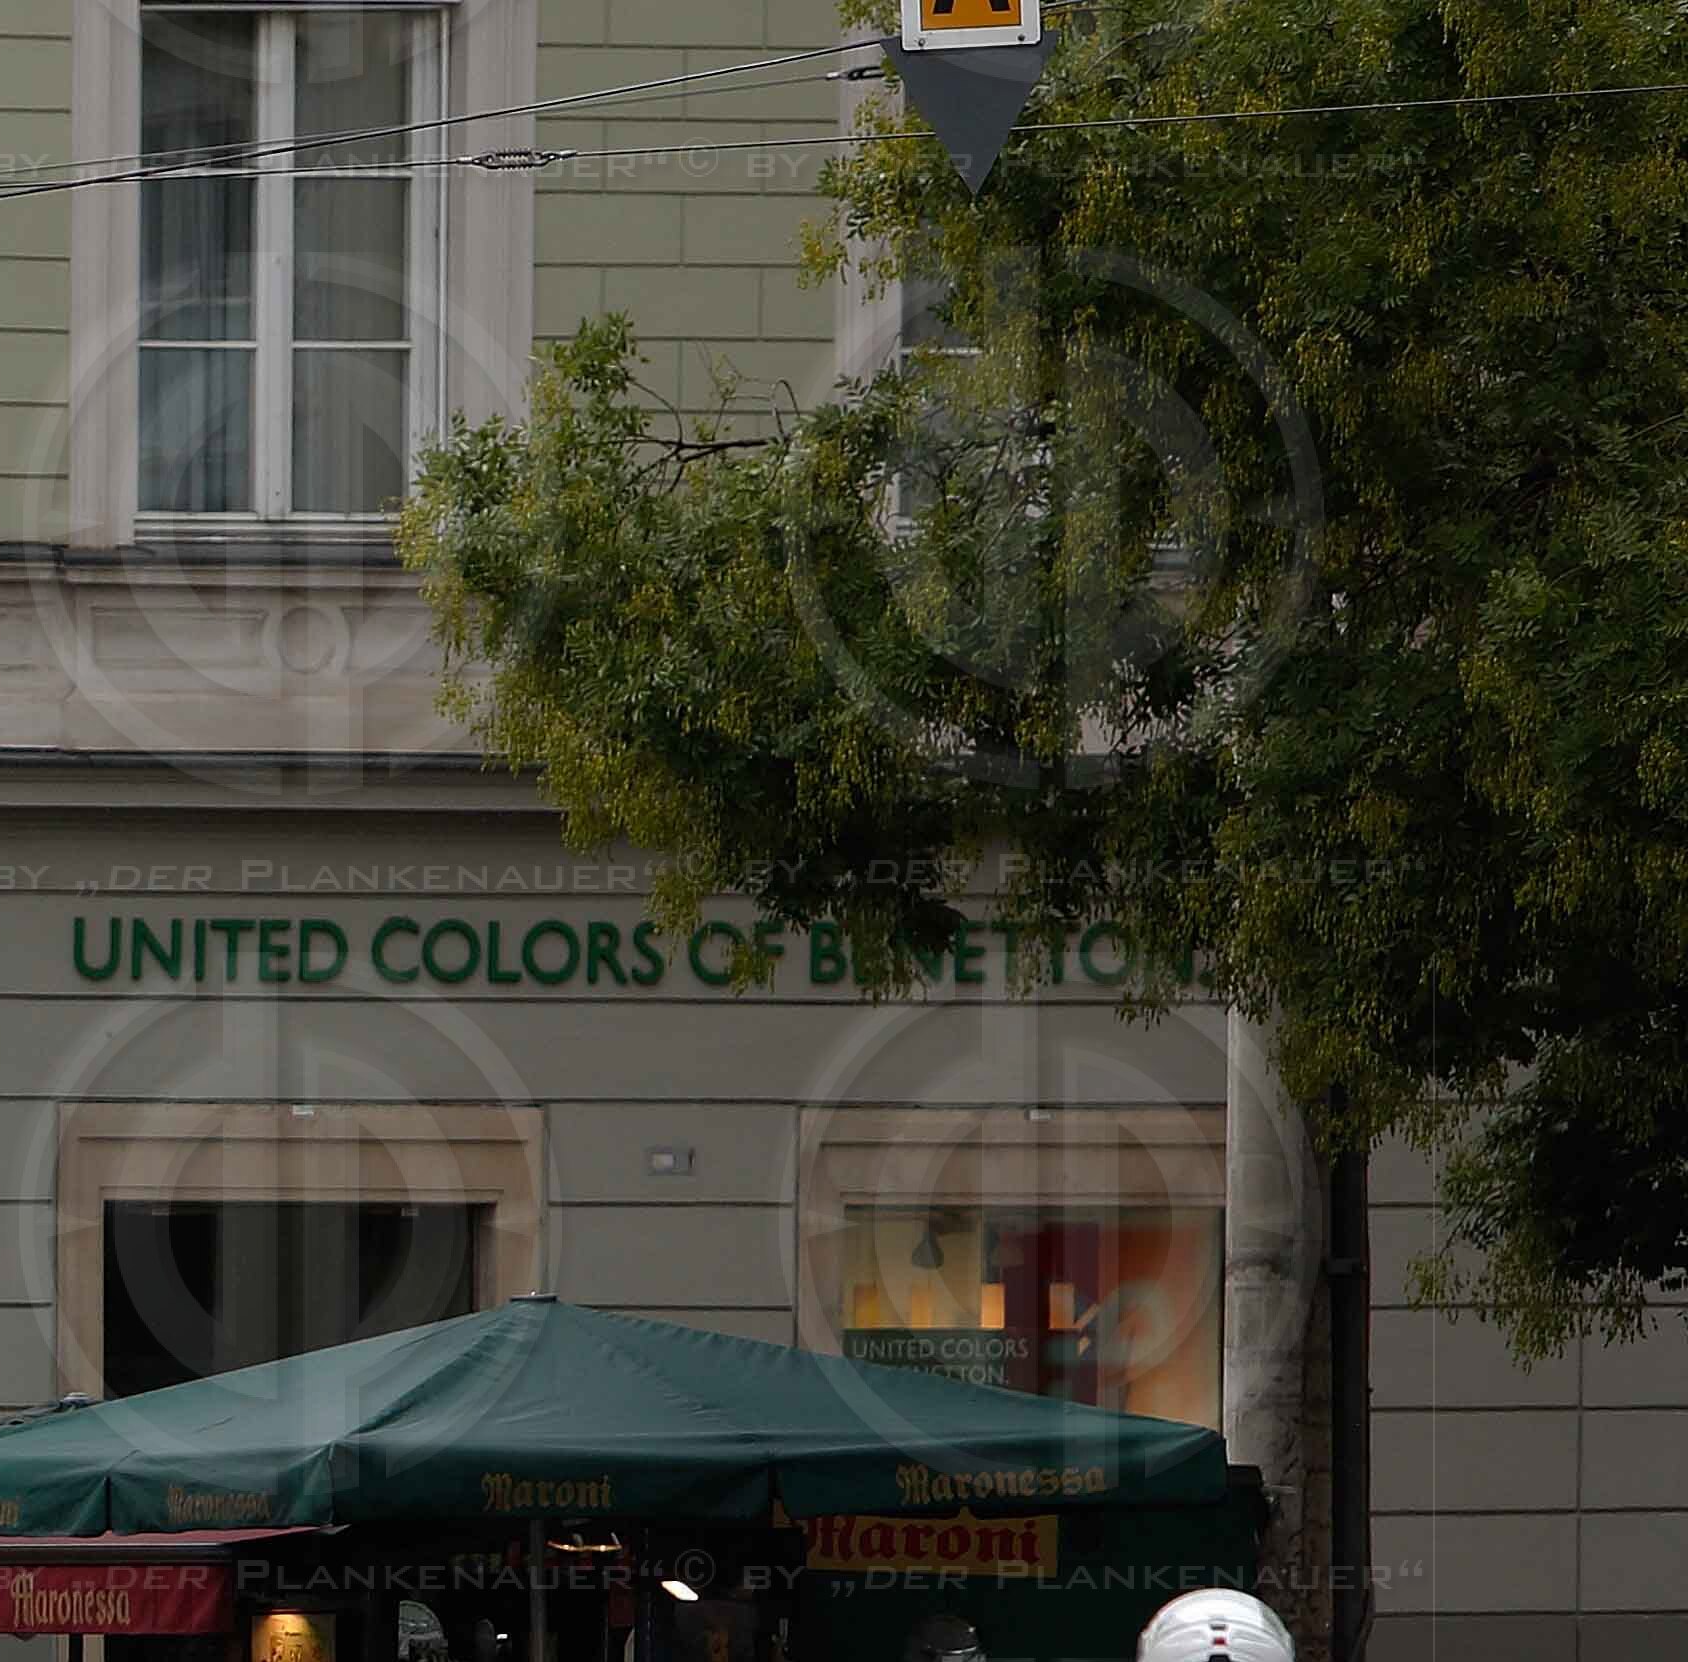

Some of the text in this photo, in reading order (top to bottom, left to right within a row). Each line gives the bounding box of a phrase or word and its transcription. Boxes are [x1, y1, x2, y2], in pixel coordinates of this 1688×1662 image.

[73, 915, 349, 983] UNITED
[371, 915, 665, 985] COLORS
[853, 1338, 1029, 1359] UNITED COLORS
[481, 1472, 613, 1513] Maroni
[895, 1463, 1107, 1506] Maronessa
[10, 1569, 132, 1630] Maronessa
